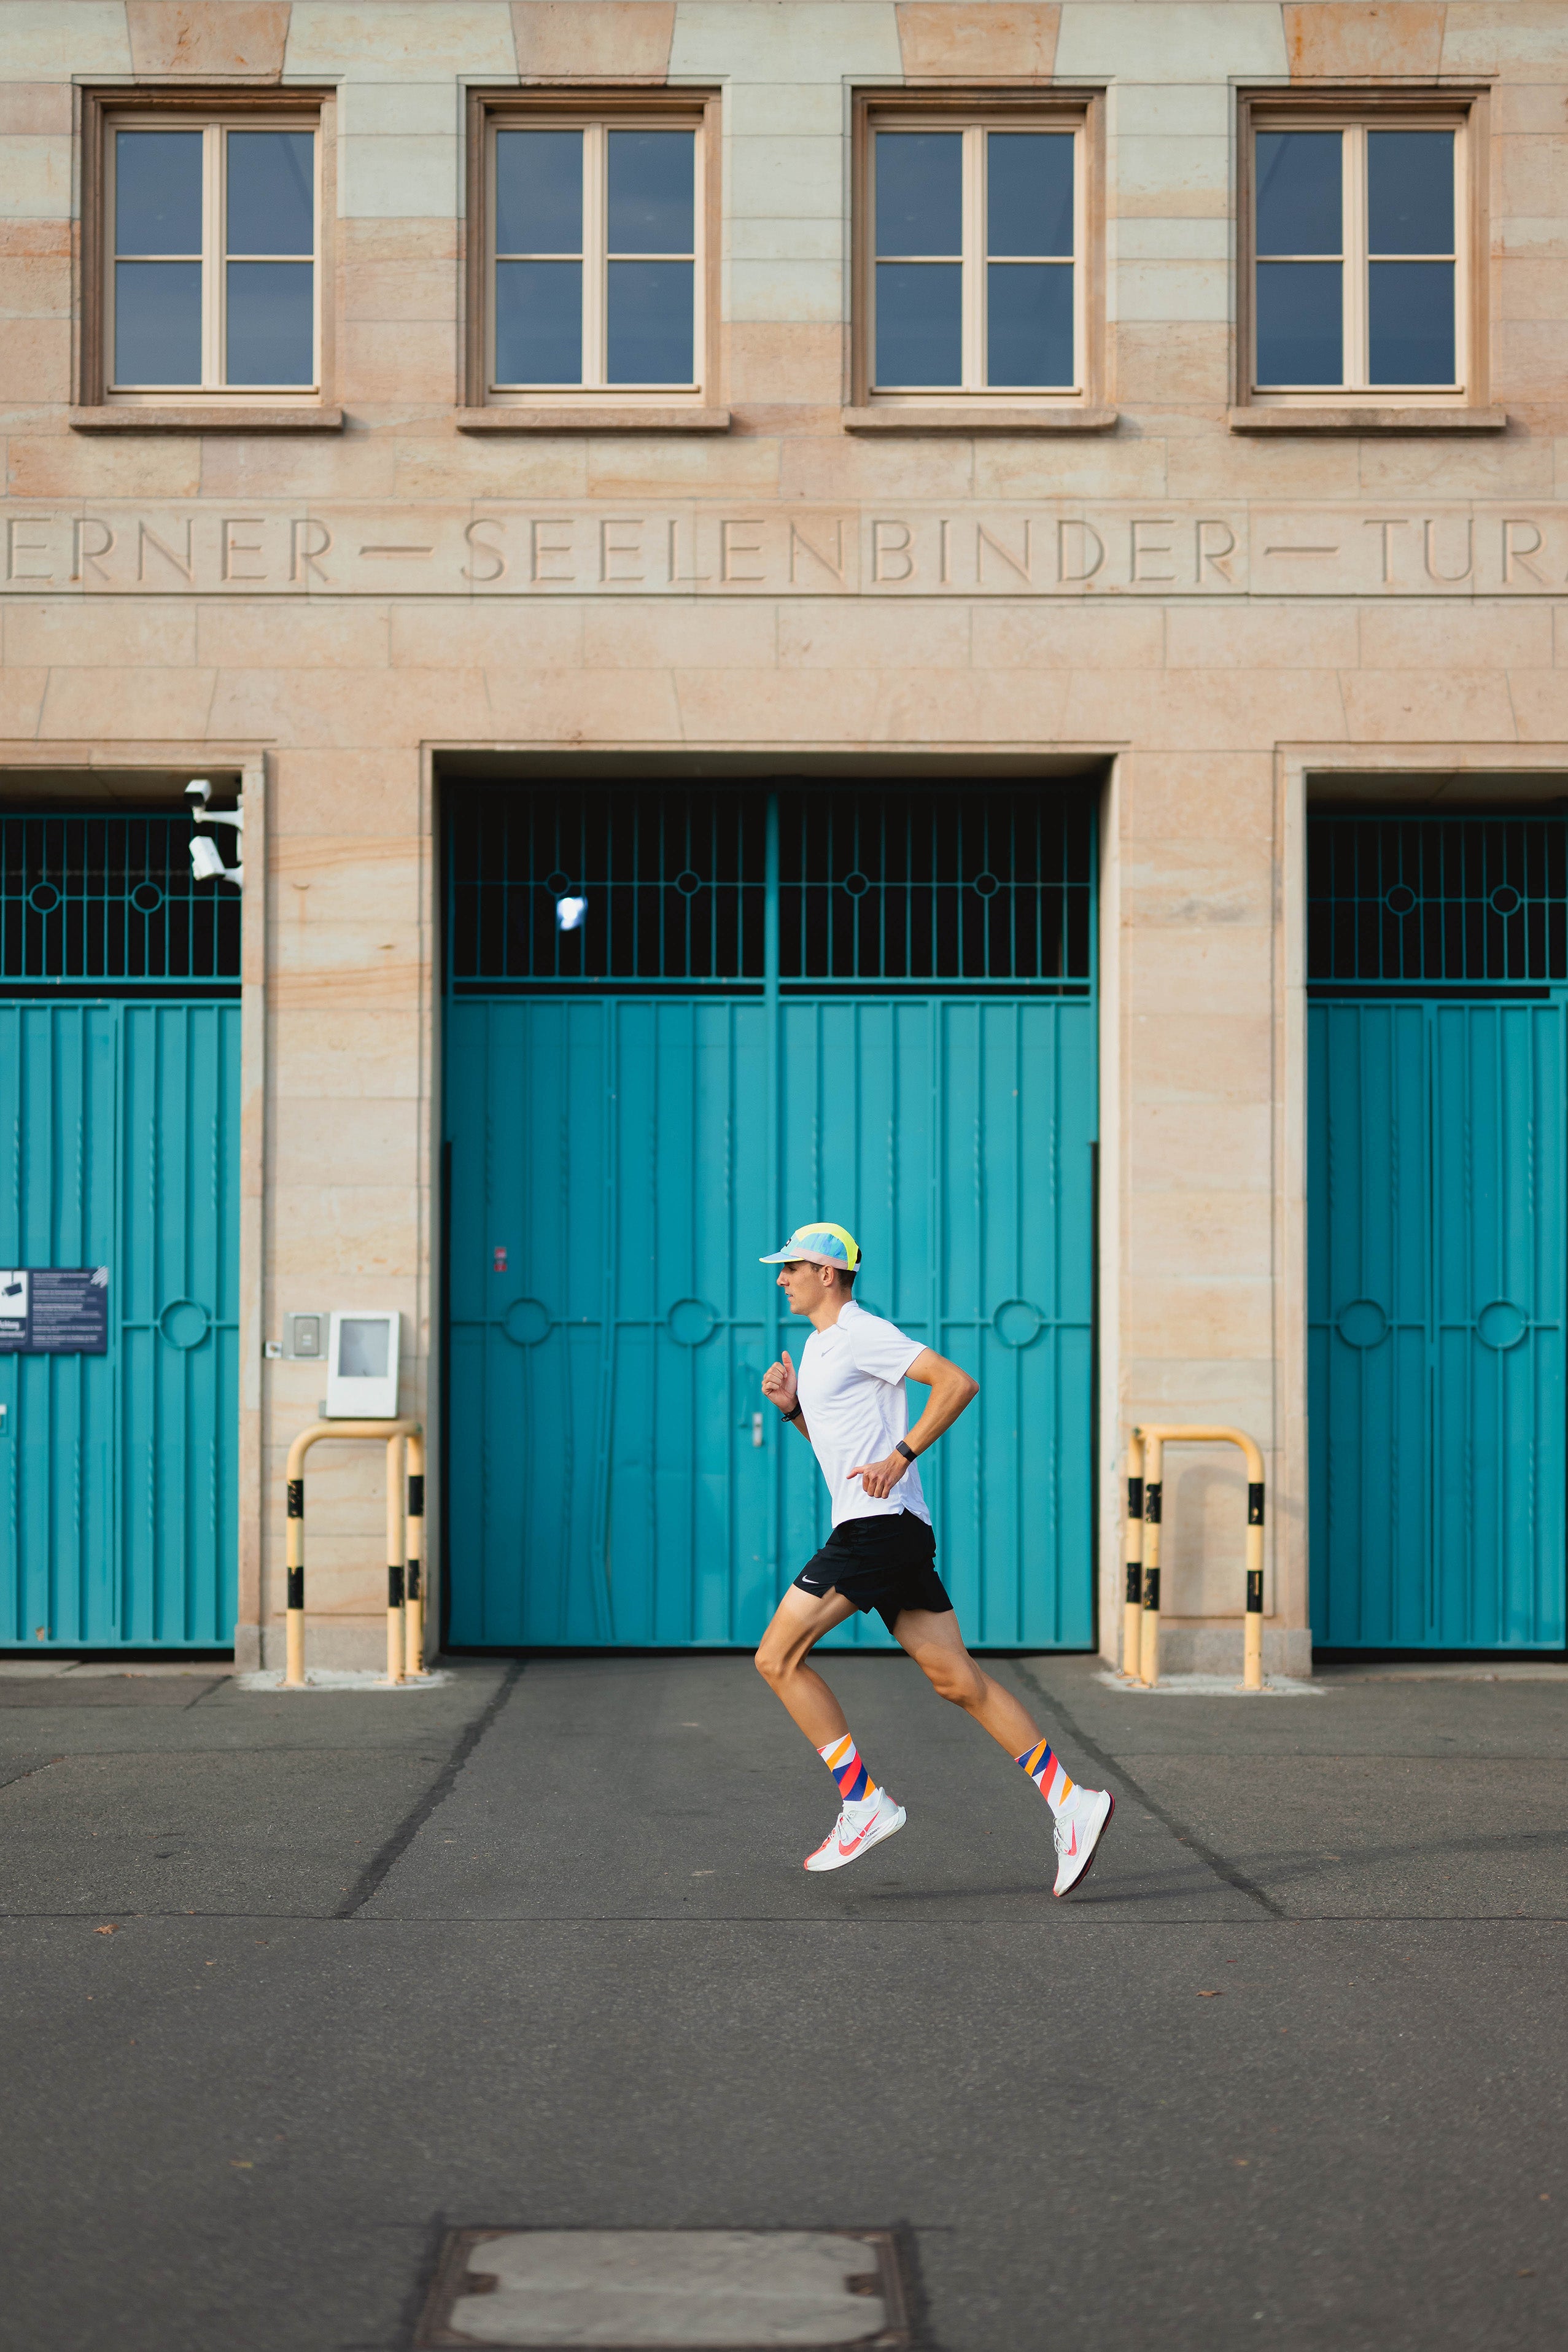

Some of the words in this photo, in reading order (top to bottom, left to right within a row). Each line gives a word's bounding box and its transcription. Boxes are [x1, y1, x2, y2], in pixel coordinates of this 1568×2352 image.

[7, 517, 335, 583] ERNER
[460, 518, 1240, 584] SEELENBINDER
[1363, 518, 1568, 584] TUR
